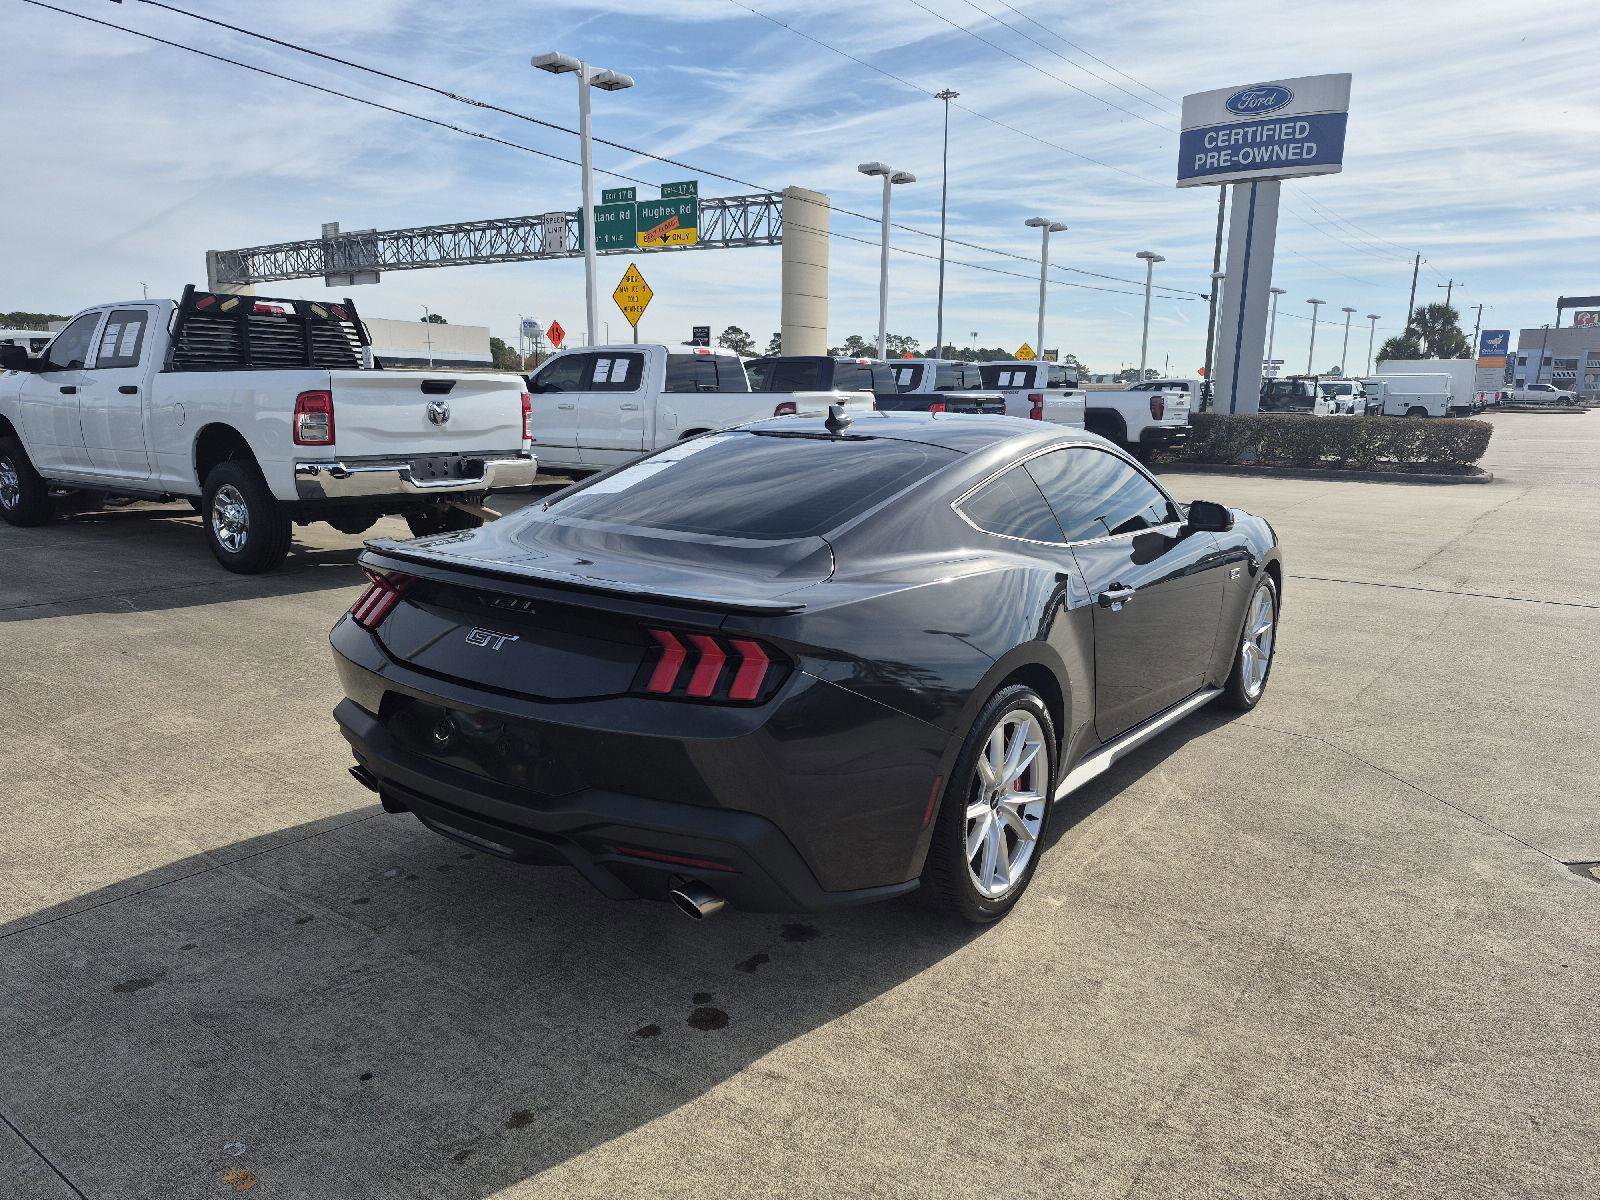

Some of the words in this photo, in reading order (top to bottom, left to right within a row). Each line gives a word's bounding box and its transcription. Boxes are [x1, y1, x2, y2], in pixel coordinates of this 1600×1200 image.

[1238, 91, 1276, 110] Ford
[1204, 121, 1310, 148] CERTIFIED
[1194, 142, 1318, 170] PRE-OWNED
[546, 216, 565, 224] SPEED
[594, 212, 615, 223] lland
[619, 210, 631, 220] Rd
[642, 206, 676, 219] Hughes
[679, 204, 691, 214] Rd
[672, 233, 690, 241] ONLY
[465, 627, 519, 650] GT
